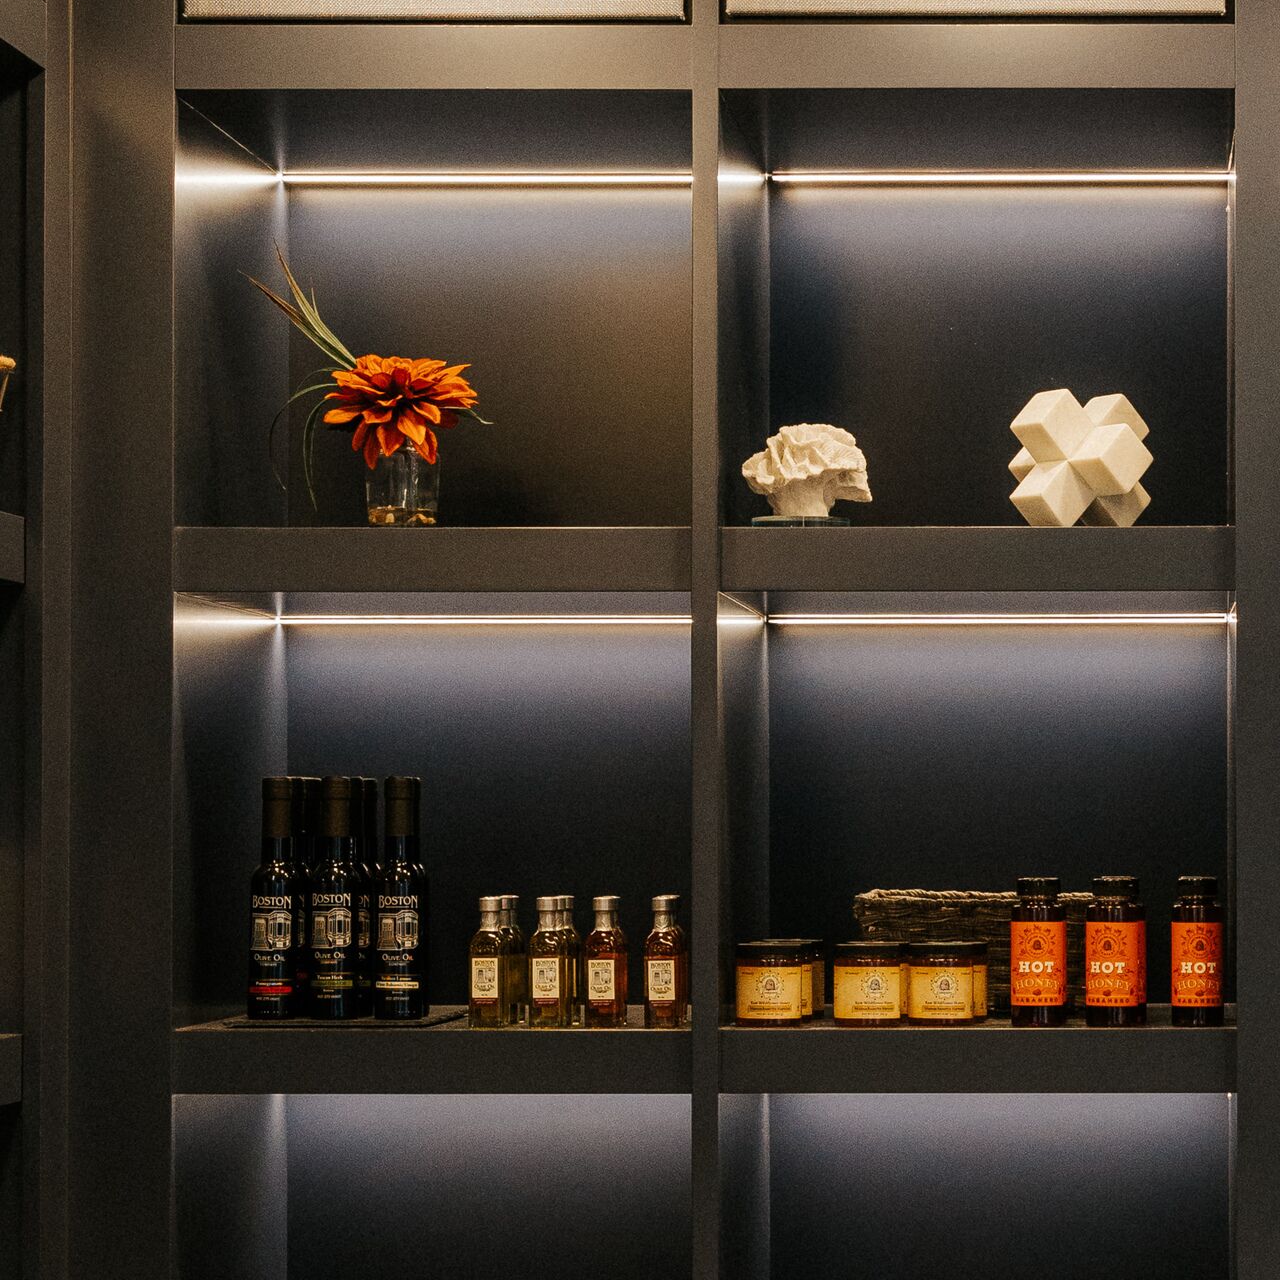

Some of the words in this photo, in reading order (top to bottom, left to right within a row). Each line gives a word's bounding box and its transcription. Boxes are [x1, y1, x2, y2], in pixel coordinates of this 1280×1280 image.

[252, 895, 292, 909] BOSTON
[312, 893, 351, 907] BOSTON
[378, 895, 418, 909] BOSTON
[1019, 961, 1054, 973] HOT
[1090, 961, 1126, 974] HOT
[1181, 962, 1216, 974] HOT
[1015, 978, 1059, 990] HONEY
[1088, 978, 1130, 991] HONEY
